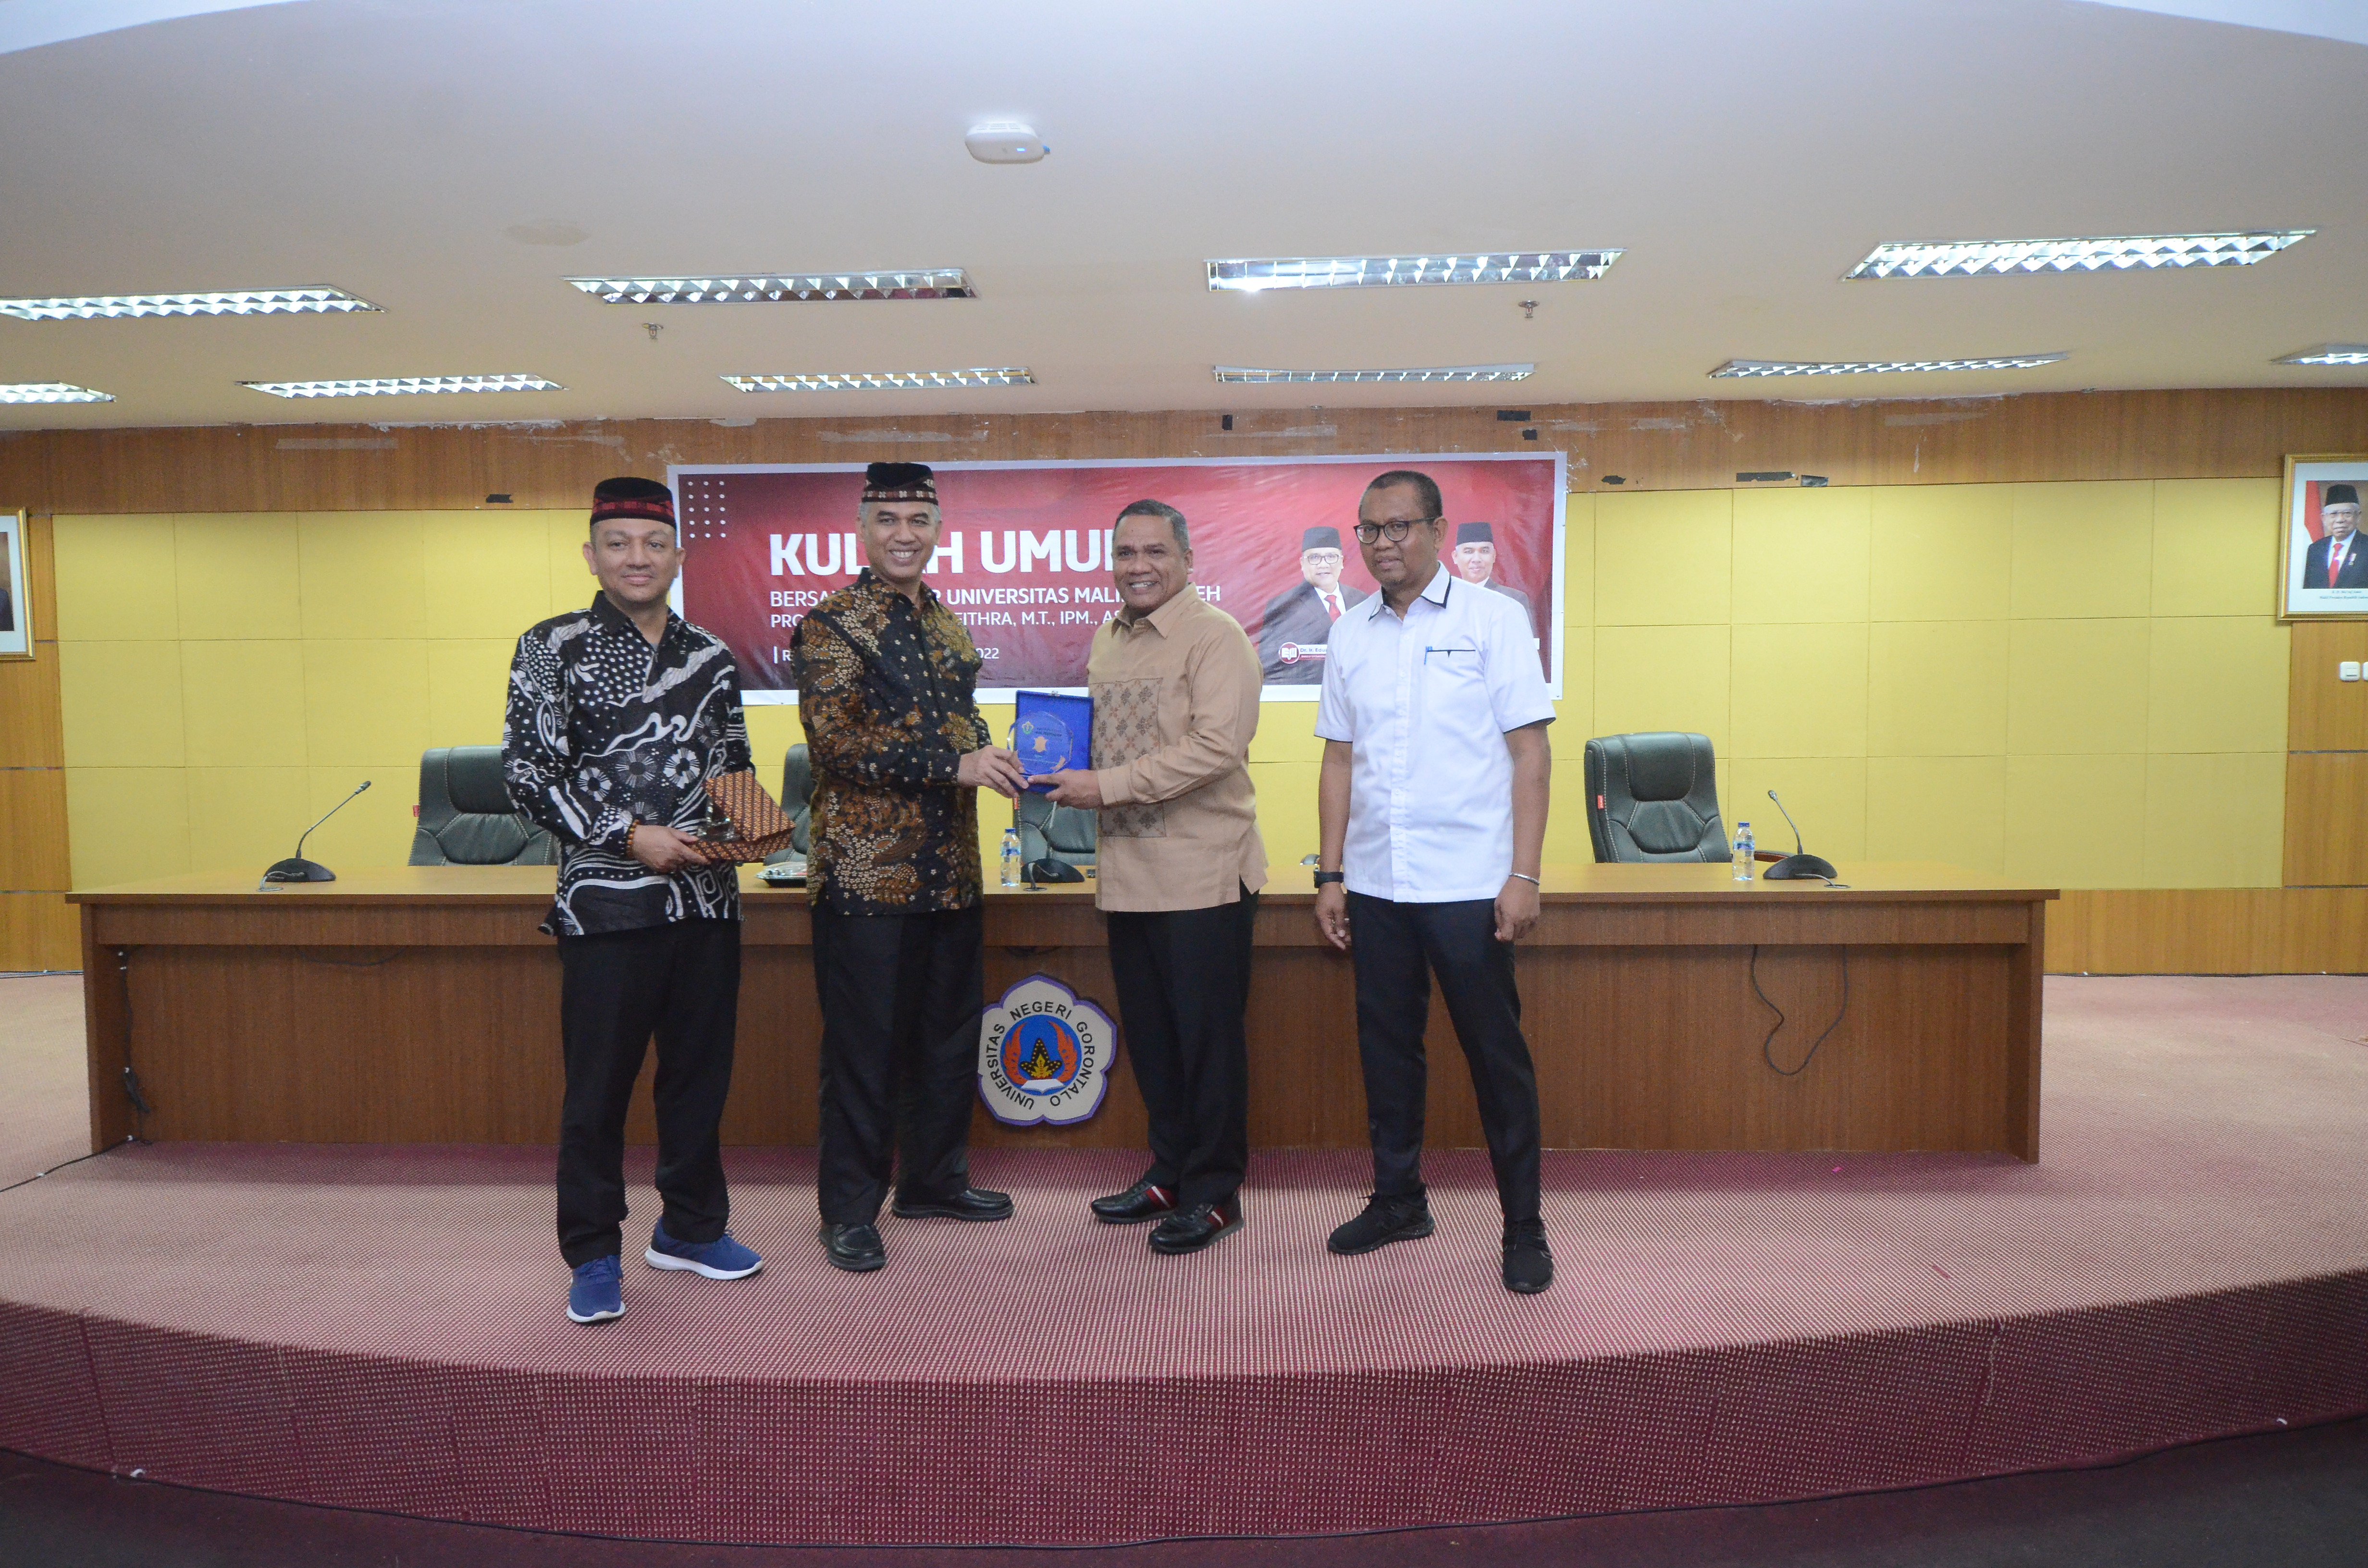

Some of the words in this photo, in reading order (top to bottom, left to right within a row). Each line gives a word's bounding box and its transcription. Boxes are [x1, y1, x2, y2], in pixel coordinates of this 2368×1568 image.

[770, 532, 963, 576] KULH
[980, 529, 1113, 572] UMU
[947, 588, 1069, 605] UNIVERSITAS
[1022, 611, 1055, 626] M.T.,
[1060, 611, 1098, 625] IPM.,
[1010, 1001, 1072, 1021] NEGERI
[986, 1024, 1035, 1110] UNIVERSITAS
[1049, 1021, 1095, 1107] GORONTALO
